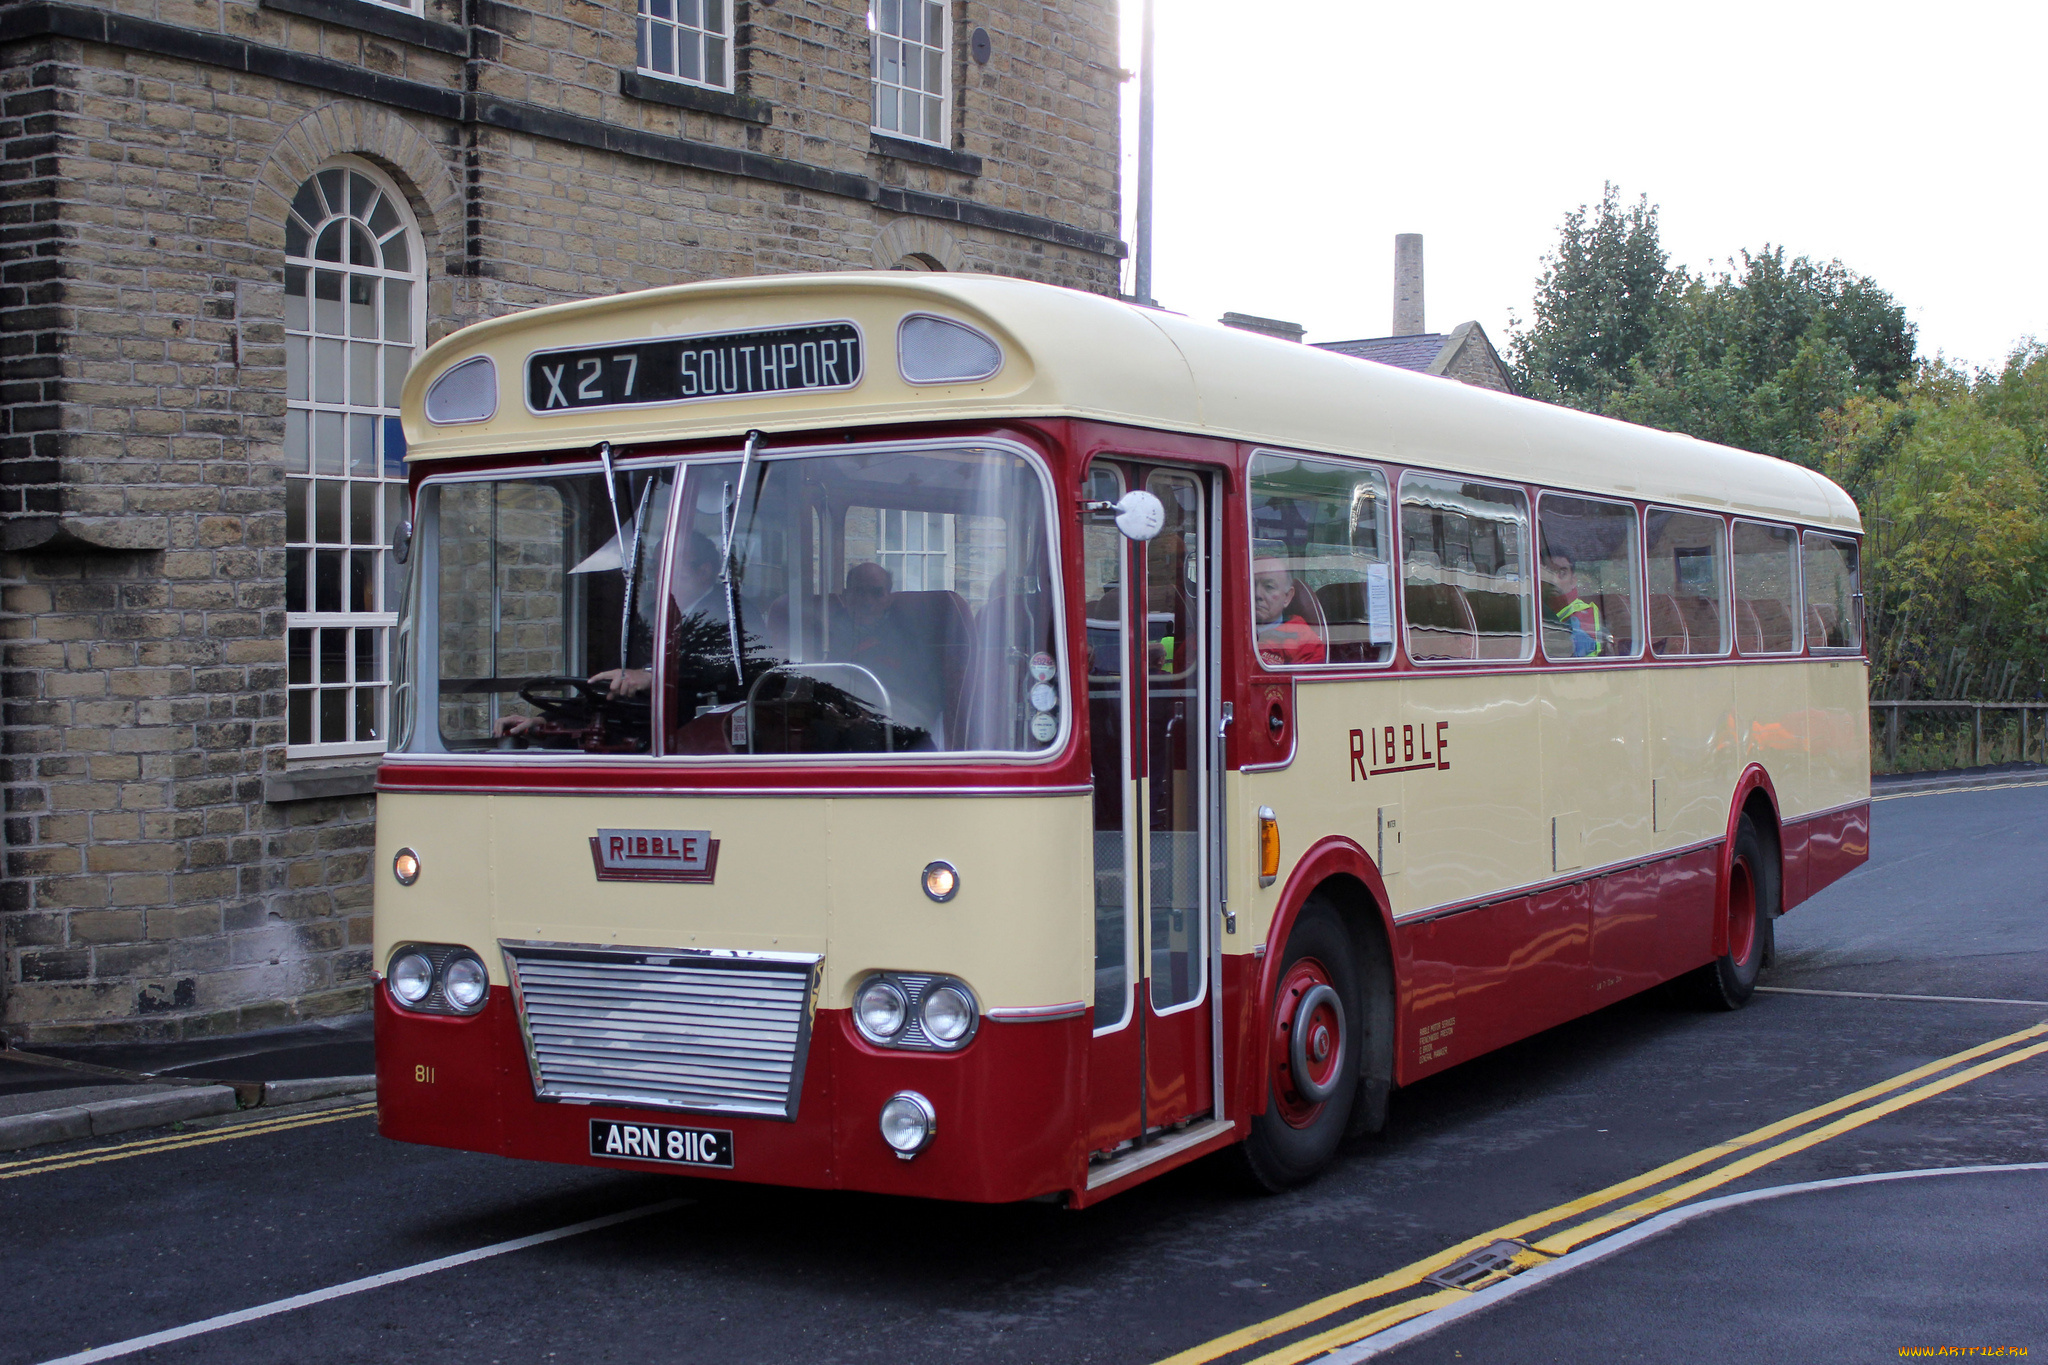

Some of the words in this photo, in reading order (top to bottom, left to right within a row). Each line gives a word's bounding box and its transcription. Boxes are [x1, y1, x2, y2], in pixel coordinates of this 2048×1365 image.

[681, 338, 857, 395] SOUTHPORT
[1349, 721, 1450, 782] RIBBLE
[609, 836, 698, 862] RIBBLE
[415, 1064, 435, 1084] 811
[605, 1124, 660, 1158] ARN
[666, 1130, 717, 1162] 811C
